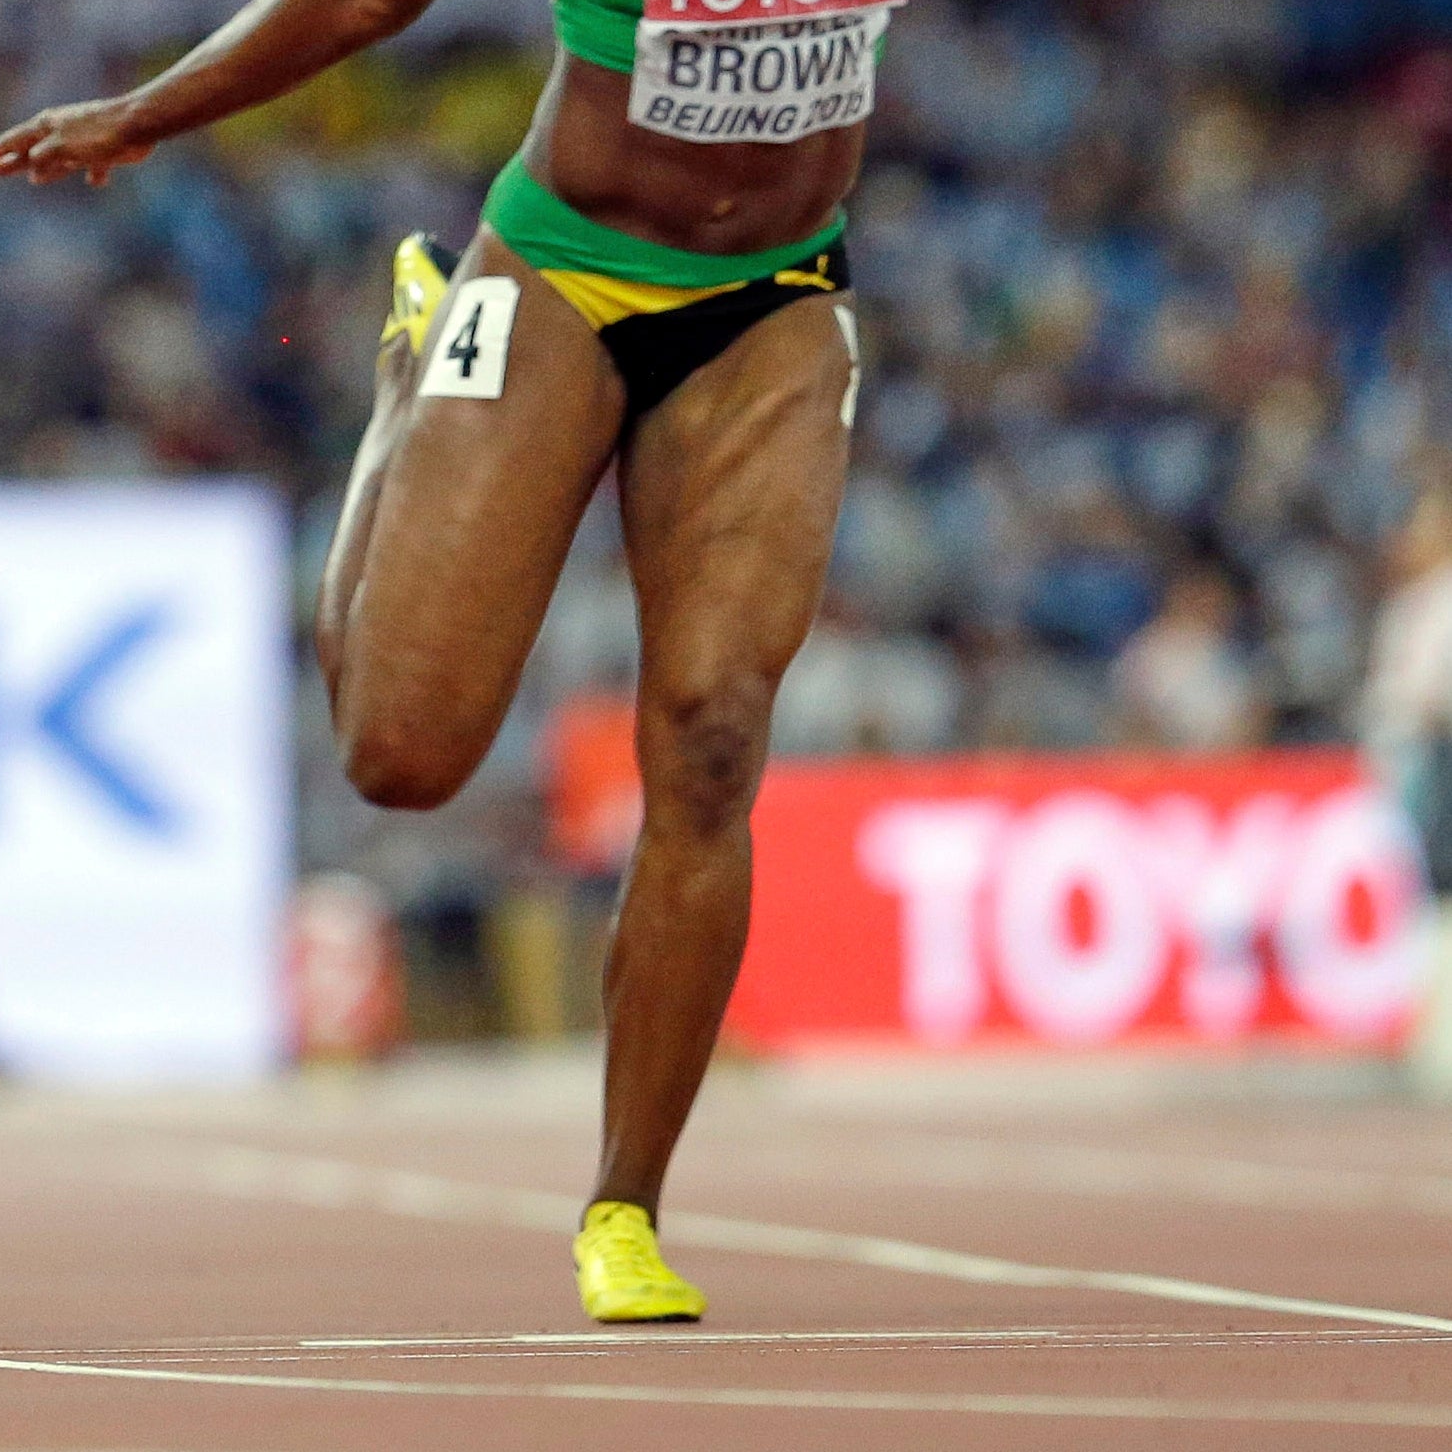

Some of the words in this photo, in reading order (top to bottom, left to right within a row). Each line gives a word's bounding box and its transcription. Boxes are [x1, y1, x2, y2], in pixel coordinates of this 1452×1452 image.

[668, 30, 865, 93] BROWN
[646, 95, 799, 135] BEIJING
[447, 302, 480, 377] 4
[856, 790, 1428, 1042] TOYO
